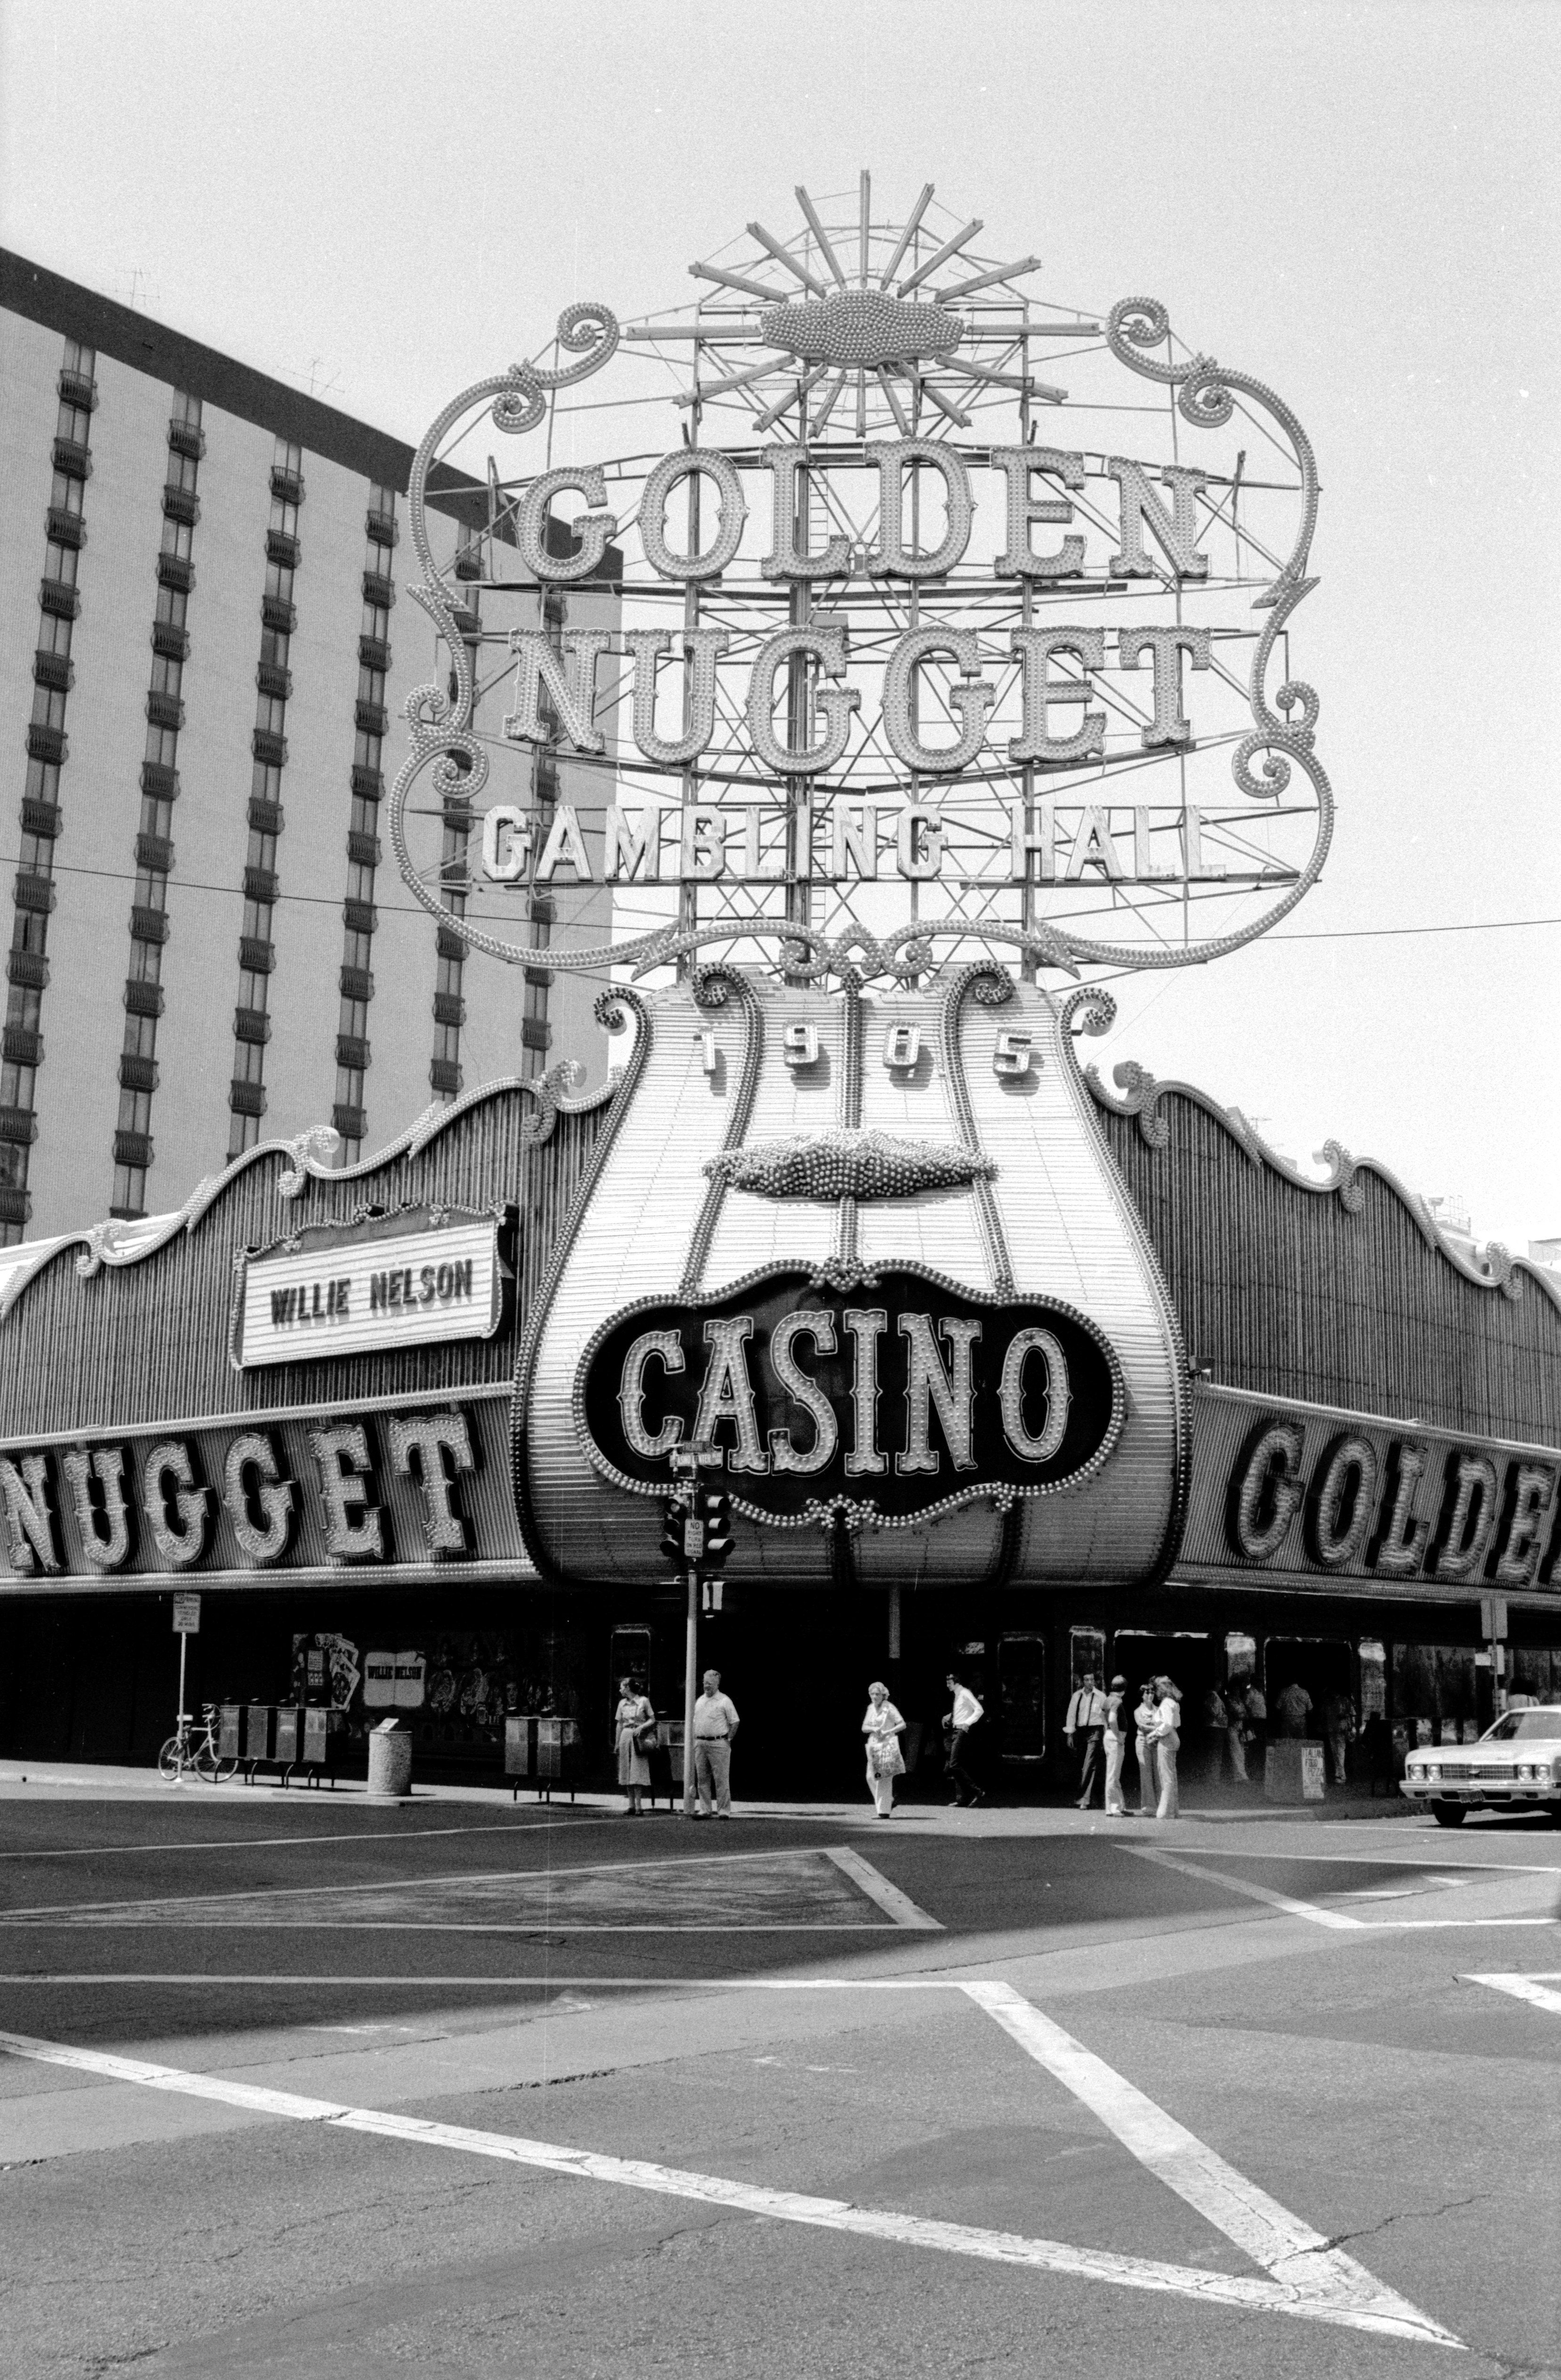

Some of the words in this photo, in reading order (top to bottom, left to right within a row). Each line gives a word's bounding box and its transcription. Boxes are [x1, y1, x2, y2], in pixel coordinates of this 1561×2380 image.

[518, 437, 1211, 581] GOLDEN
[503, 626, 1212, 775] NUGGET
[481, 804, 948, 882] GAMBLING
[1012, 803, 1226, 880] HALL
[270, 1278, 351, 1324] WILLIE
[369, 1258, 472, 1309] NELSON
[616, 1309, 1073, 1476] CASINO
[0, 1412, 475, 1572] NUGGET
[1236, 1421, 1561, 1586] GOLDE
